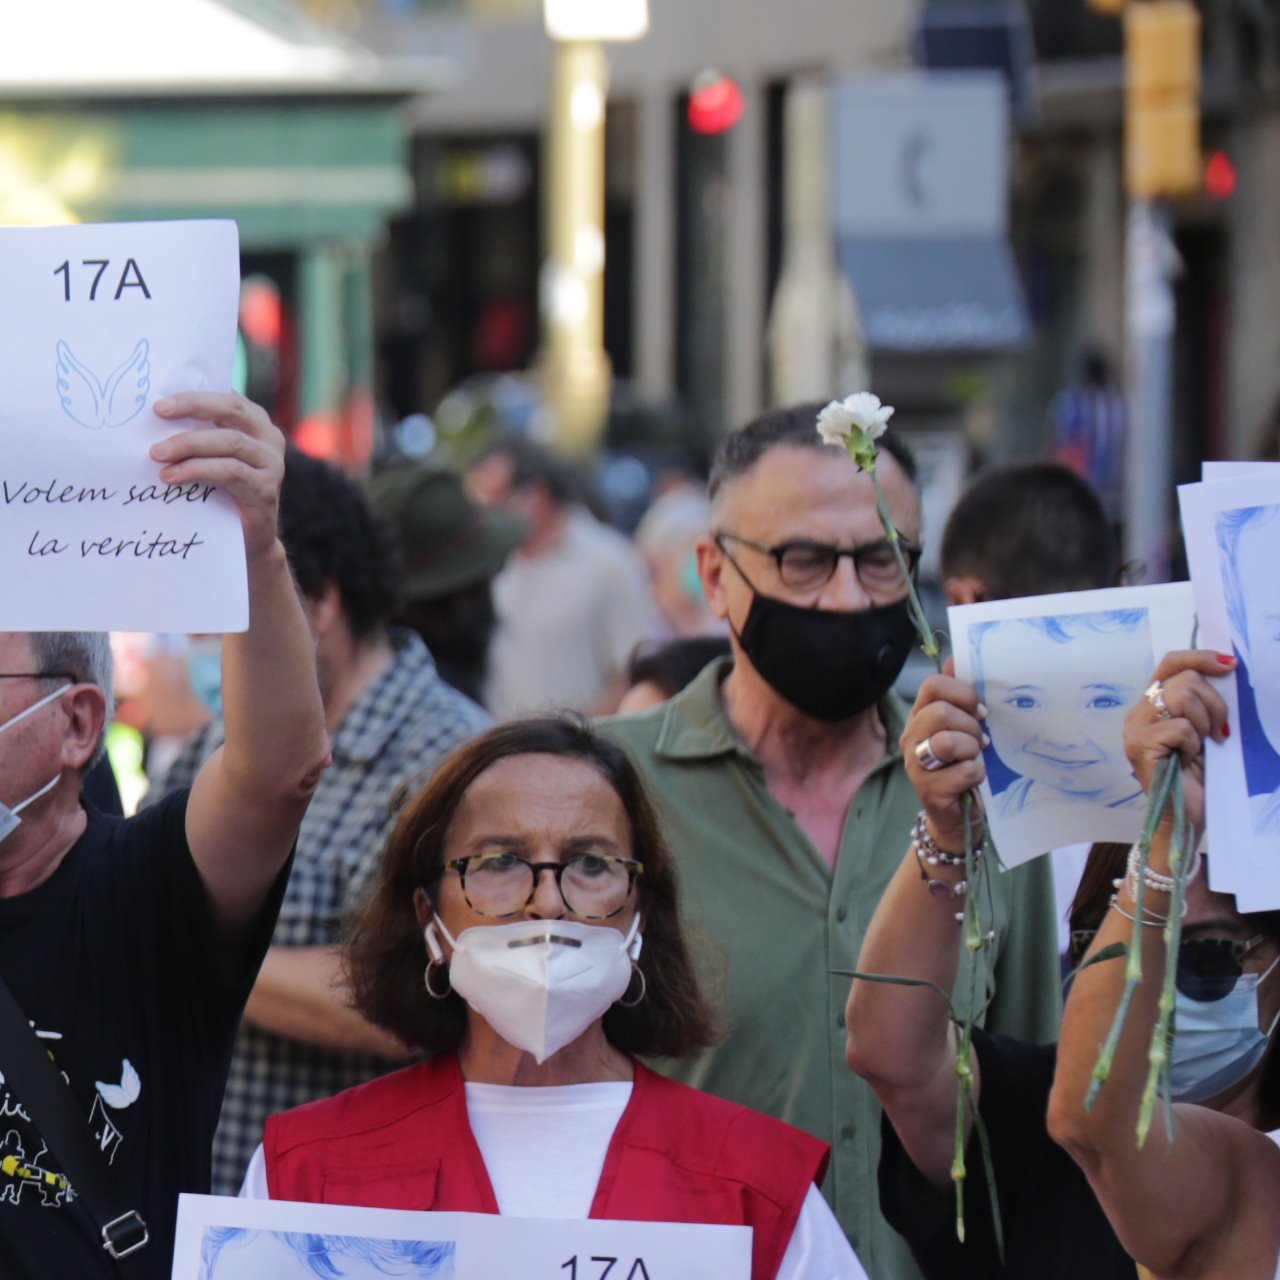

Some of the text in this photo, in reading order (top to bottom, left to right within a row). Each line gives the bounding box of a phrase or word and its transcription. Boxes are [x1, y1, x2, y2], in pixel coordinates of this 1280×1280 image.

[52, 258, 152, 303] 17A
[2, 479, 217, 506] Volem saber
[27, 530, 204, 560] la veritat
